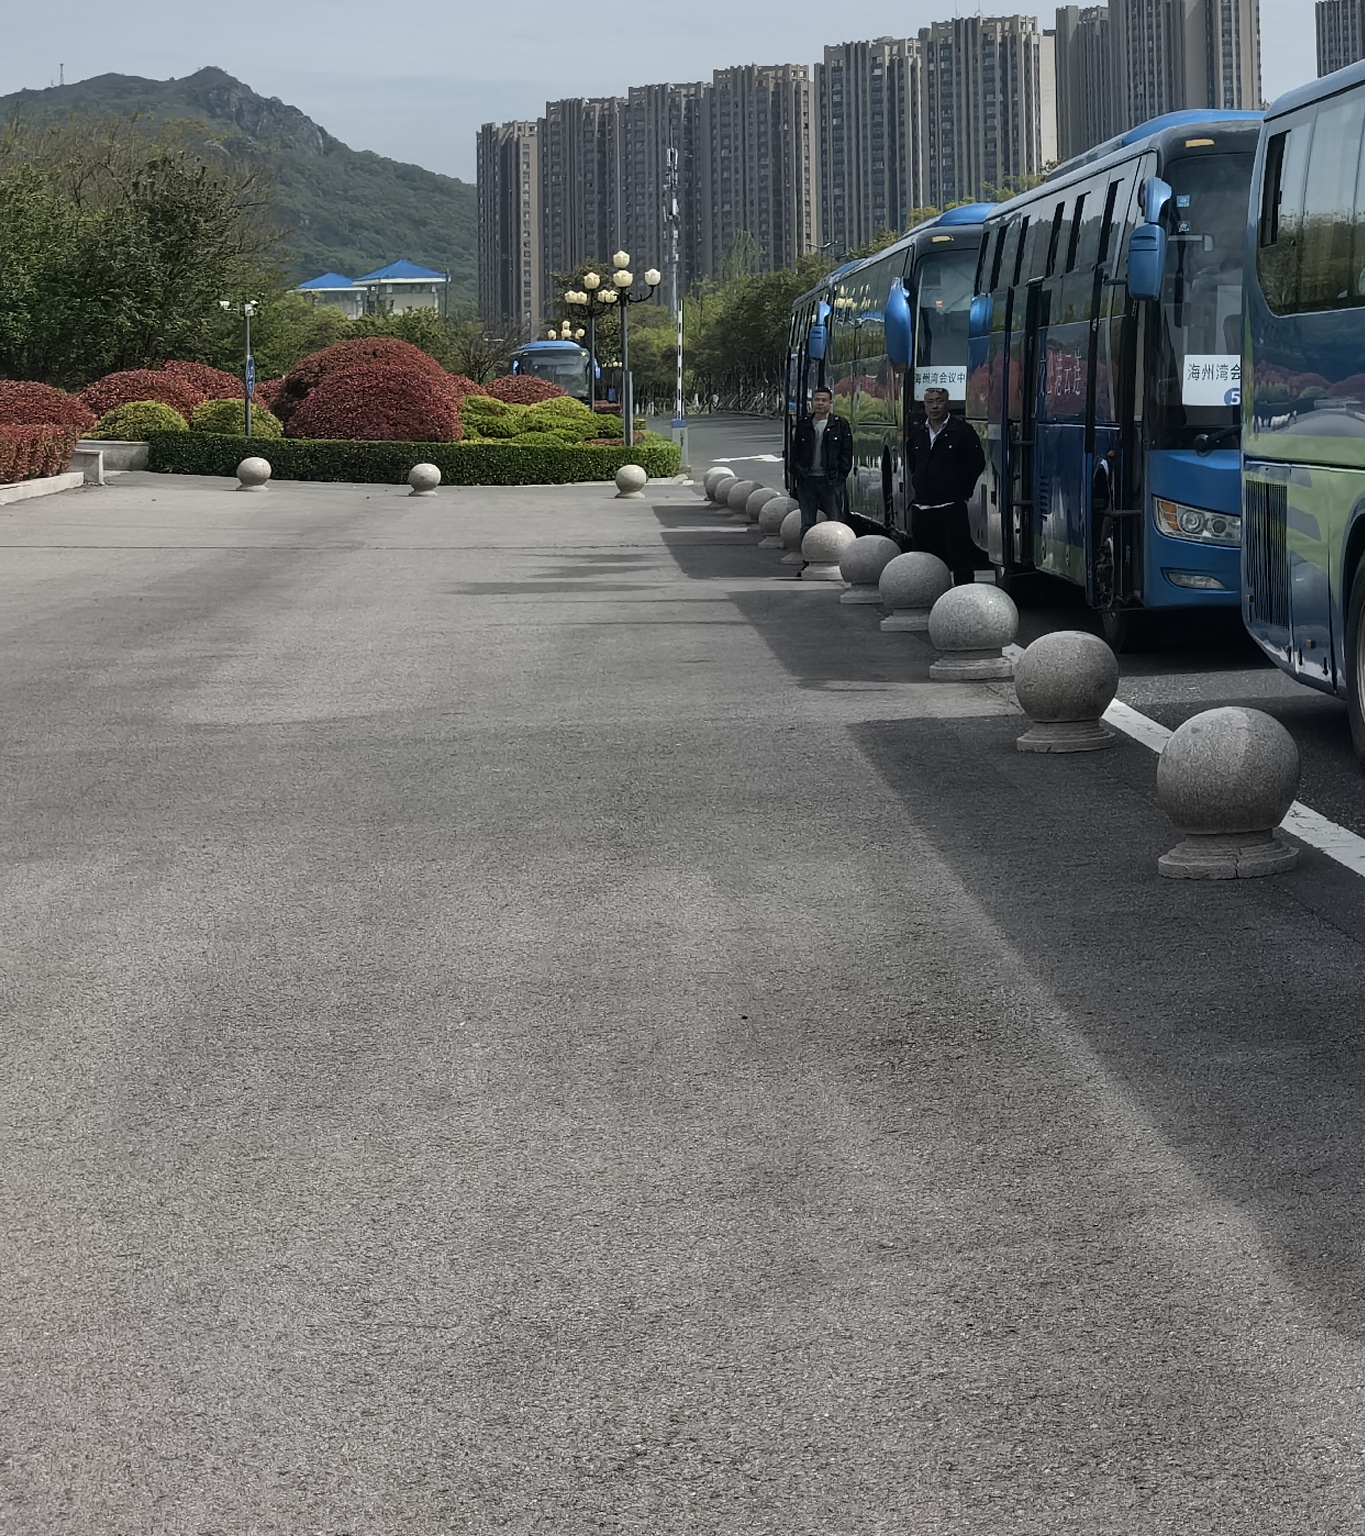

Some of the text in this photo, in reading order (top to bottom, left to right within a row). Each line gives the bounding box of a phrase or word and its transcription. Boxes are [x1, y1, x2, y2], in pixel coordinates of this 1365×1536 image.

[1186, 362, 1241, 382] 海州湾会
[1230, 391, 1241, 405] 5
